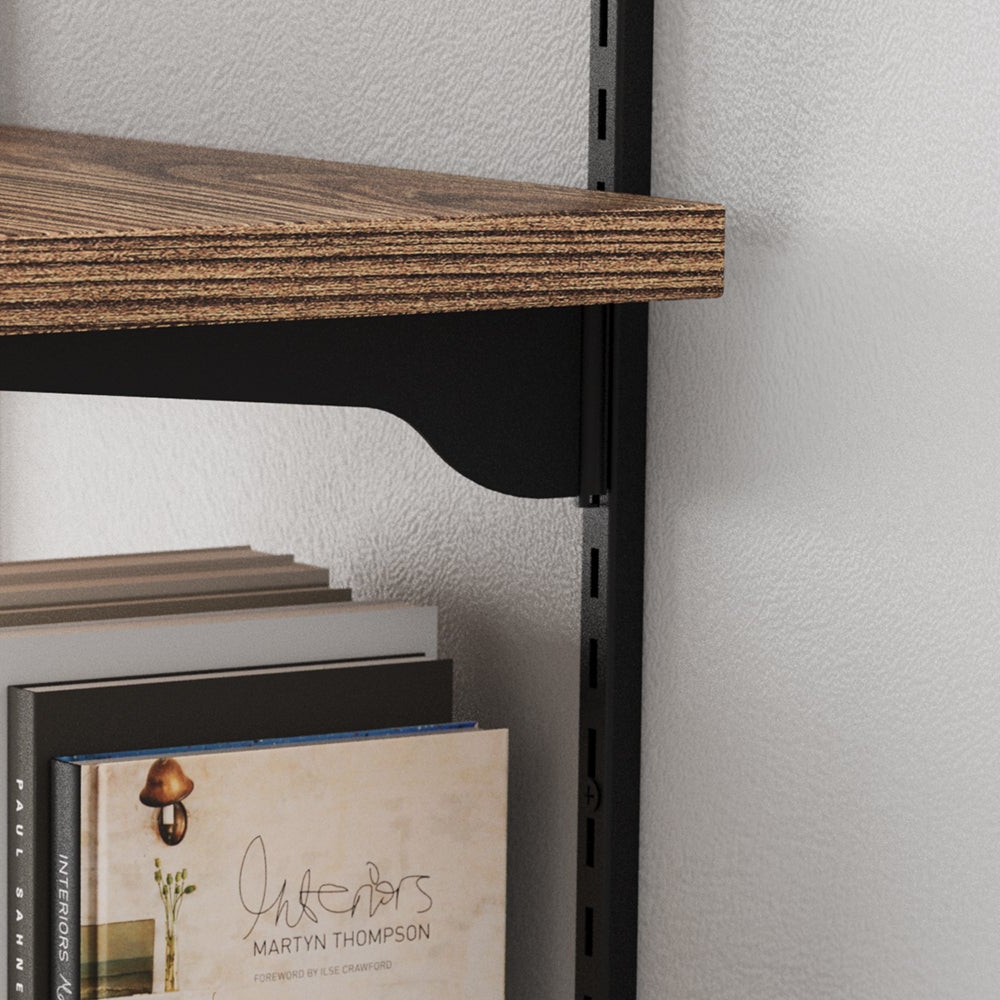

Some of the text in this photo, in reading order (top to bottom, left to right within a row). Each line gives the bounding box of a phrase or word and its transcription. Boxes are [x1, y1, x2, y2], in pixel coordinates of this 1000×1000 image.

[15, 778, 25, 858] PAUL
[57, 853, 70, 963] INTERIORS
[238, 834, 433, 940] Interiors
[252, 923, 431, 957] MARTYN THOMPSON
[253, 959, 393, 983] FOREWORD BY ILSE CRAWFORD
